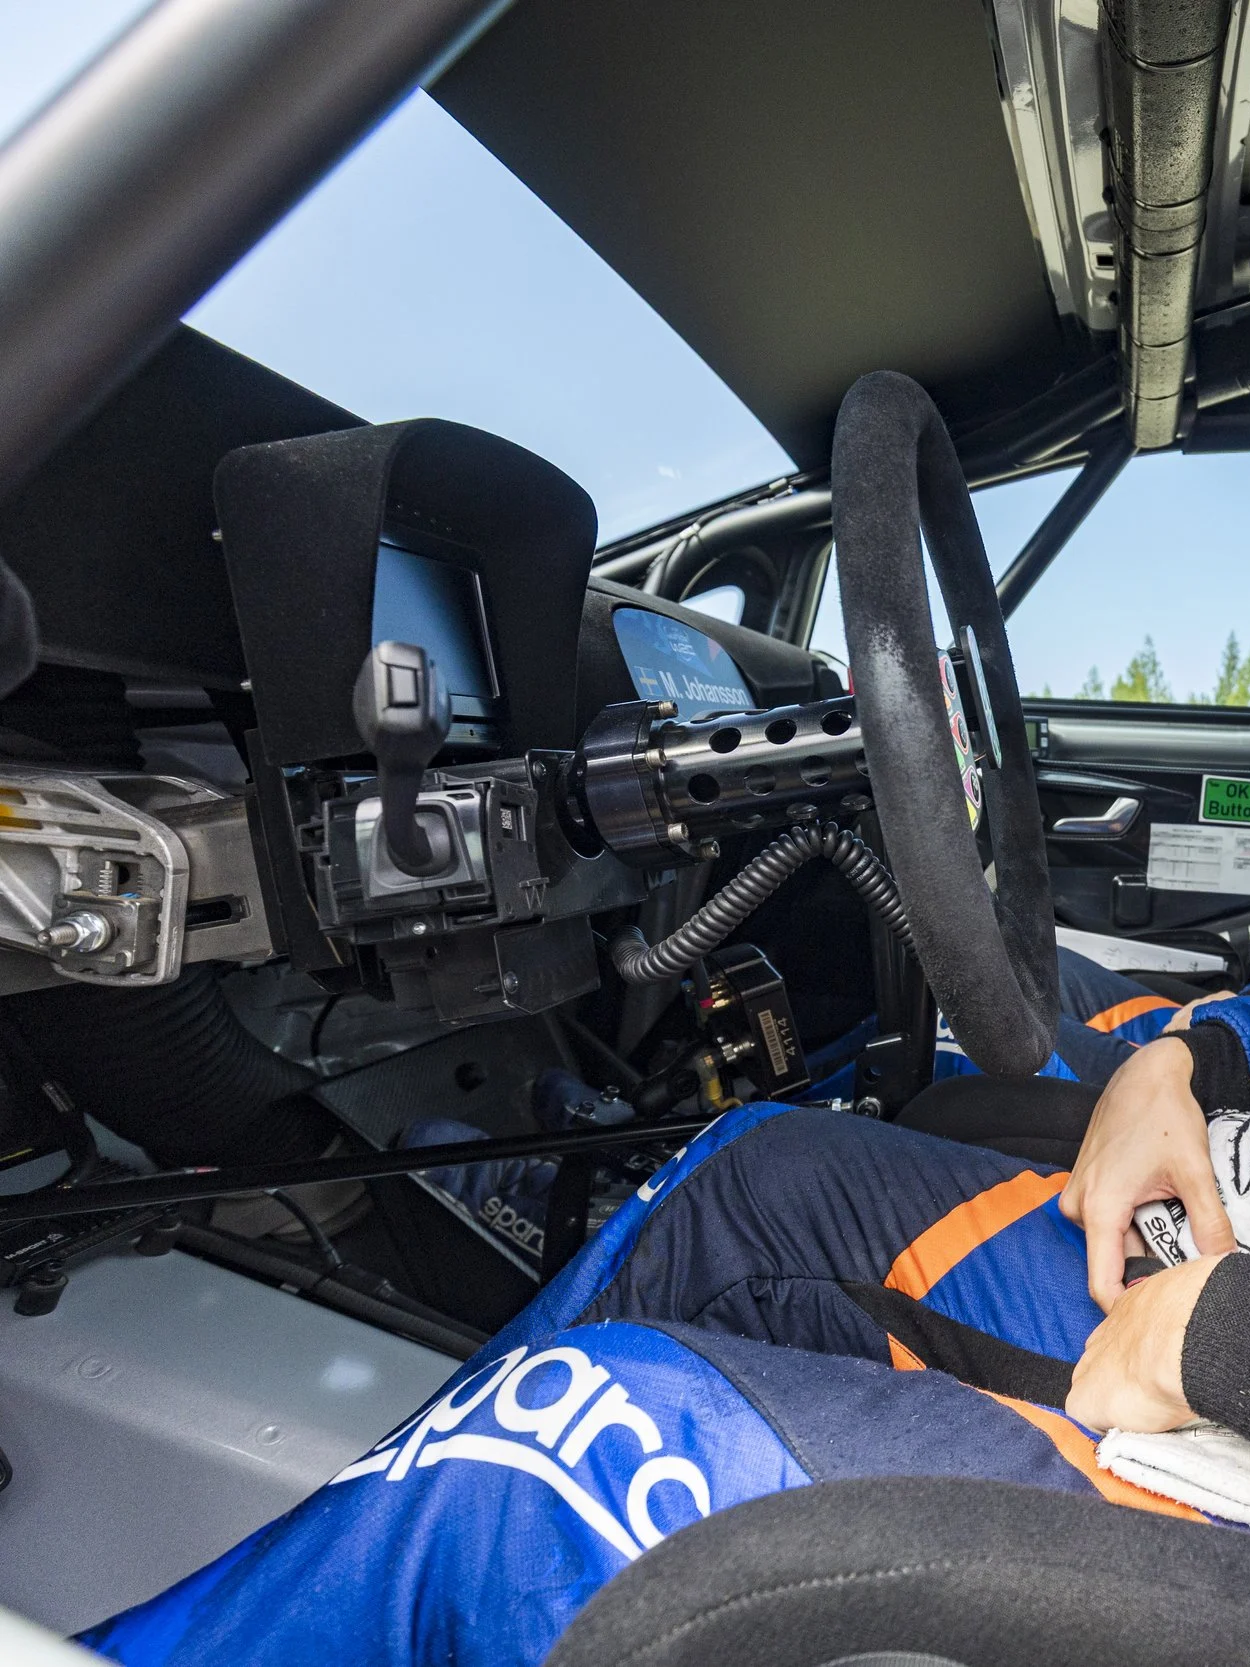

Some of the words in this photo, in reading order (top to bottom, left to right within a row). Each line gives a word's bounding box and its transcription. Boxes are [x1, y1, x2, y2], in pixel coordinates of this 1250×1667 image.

[658, 670, 683, 700] M.
[682, 674, 750, 706] Johansson
[1226, 783, 1250, 799] OK
